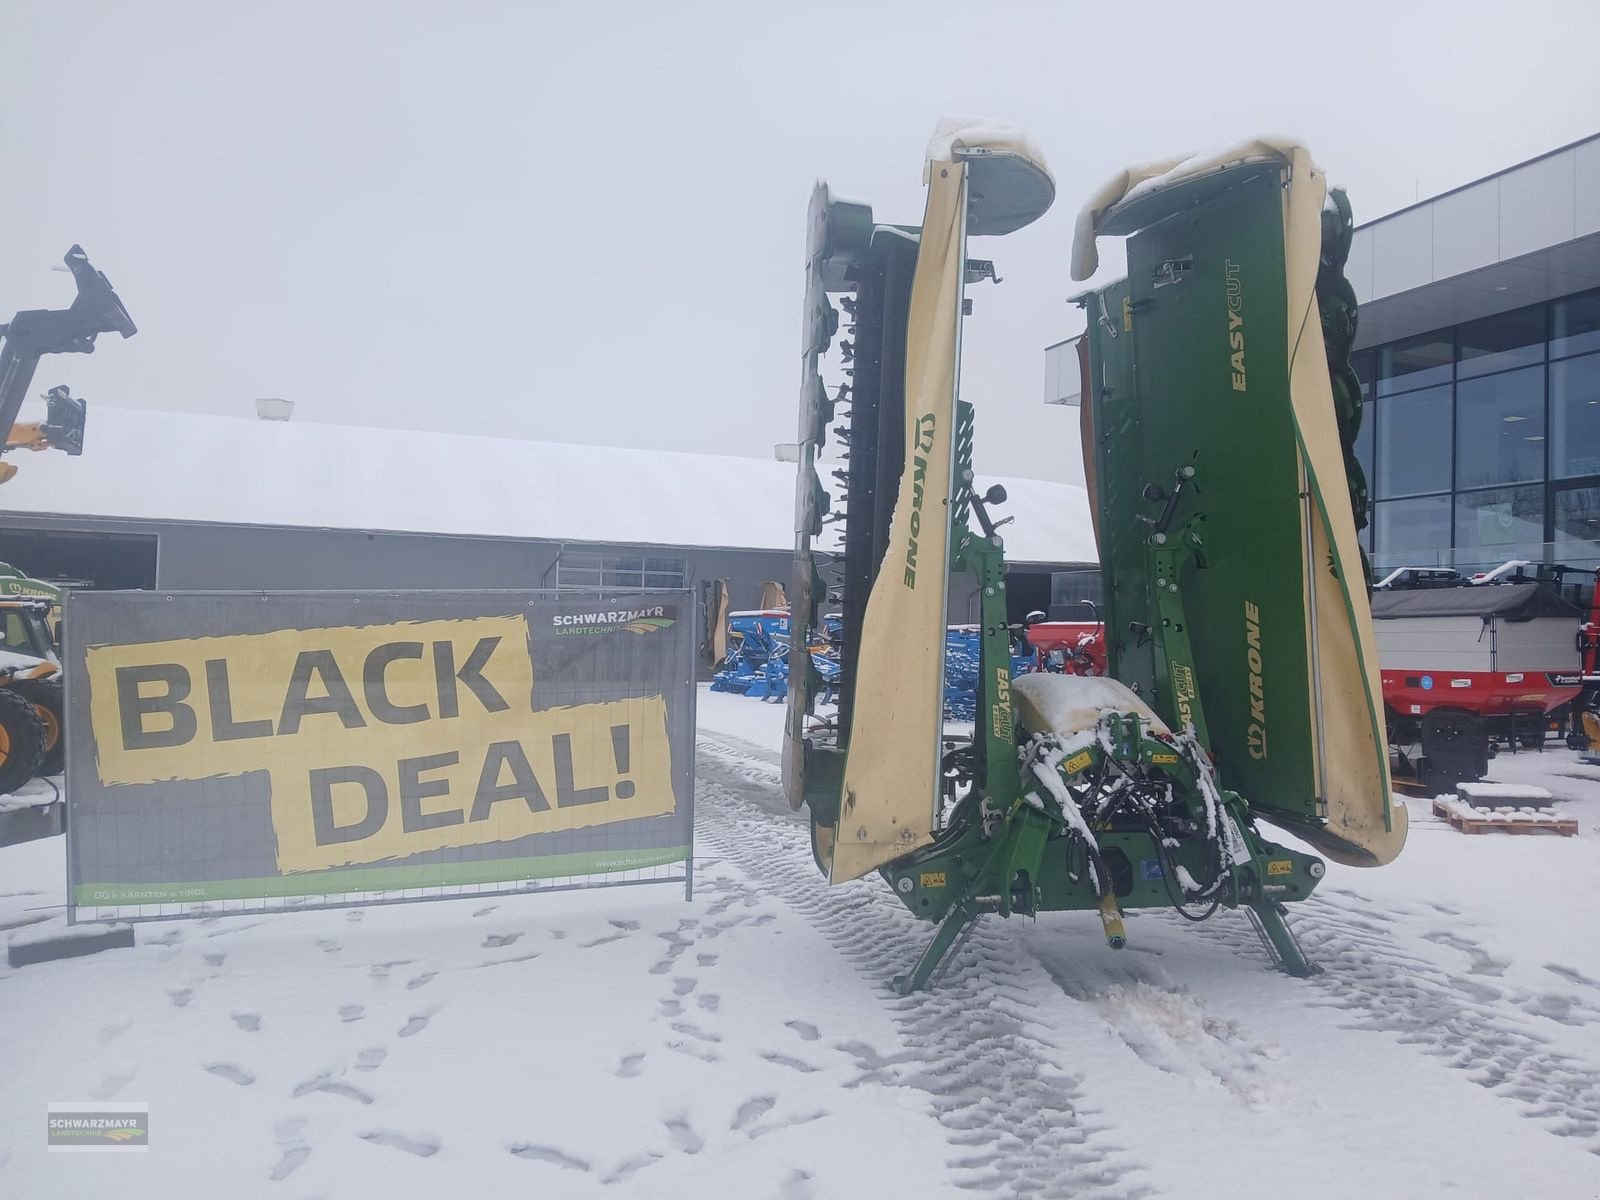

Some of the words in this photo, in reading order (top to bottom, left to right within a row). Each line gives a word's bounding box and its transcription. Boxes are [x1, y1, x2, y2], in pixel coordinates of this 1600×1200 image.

[1225, 258, 1247, 392] EASYCUT
[903, 455, 928, 590] KRONE
[552, 606, 664, 626] SCHWARZMAYR
[1245, 600, 1265, 723] KRONE
[115, 636, 511, 751] BLACK
[997, 668, 1013, 745] EASYCUT
[309, 724, 636, 847] DEAL!
[179, 888, 207, 897] TIROL
